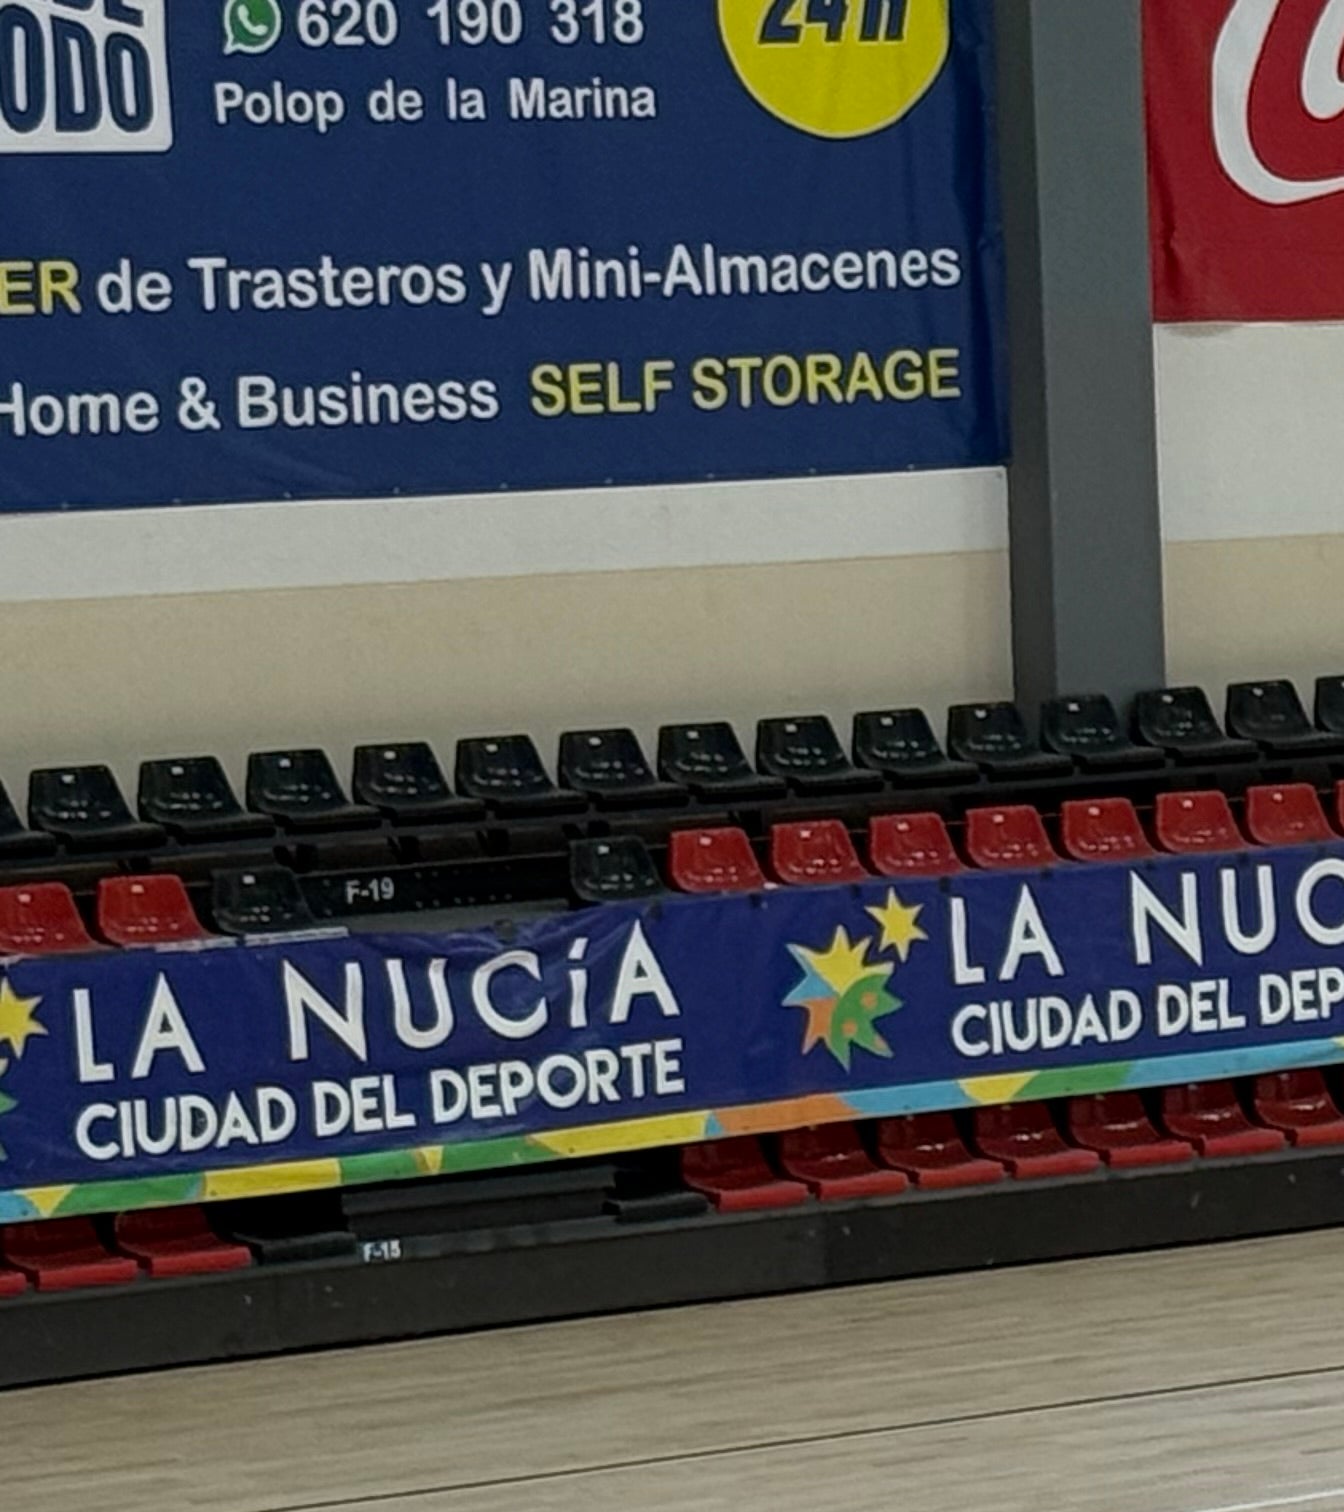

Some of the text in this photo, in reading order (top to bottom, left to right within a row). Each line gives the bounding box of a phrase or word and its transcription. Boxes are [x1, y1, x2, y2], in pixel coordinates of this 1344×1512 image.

[299, 0, 644, 47] 620 190 318
[214, 77, 657, 133] Polop de la Marina
[97, 257, 173, 313] de
[186, 256, 467, 311] Trasteros
[478, 259, 513, 316] y
[528, 245, 961, 303] Mini-Almacenes
[177, 376, 222, 430] &
[236, 370, 499, 429] Business
[530, 361, 674, 416] SELF
[691, 348, 961, 410] STORAGE
[345, 877, 395, 904] F-19
[946, 884, 1063, 984] LA
[73, 972, 205, 1083] LA
[951, 992, 1142, 1057] CIUDAD
[1157, 977, 1246, 1037] DEL
[75, 1038, 686, 1160] CIUDAD DEL DEPORTE
[363, 1240, 401, 1263] F-15
